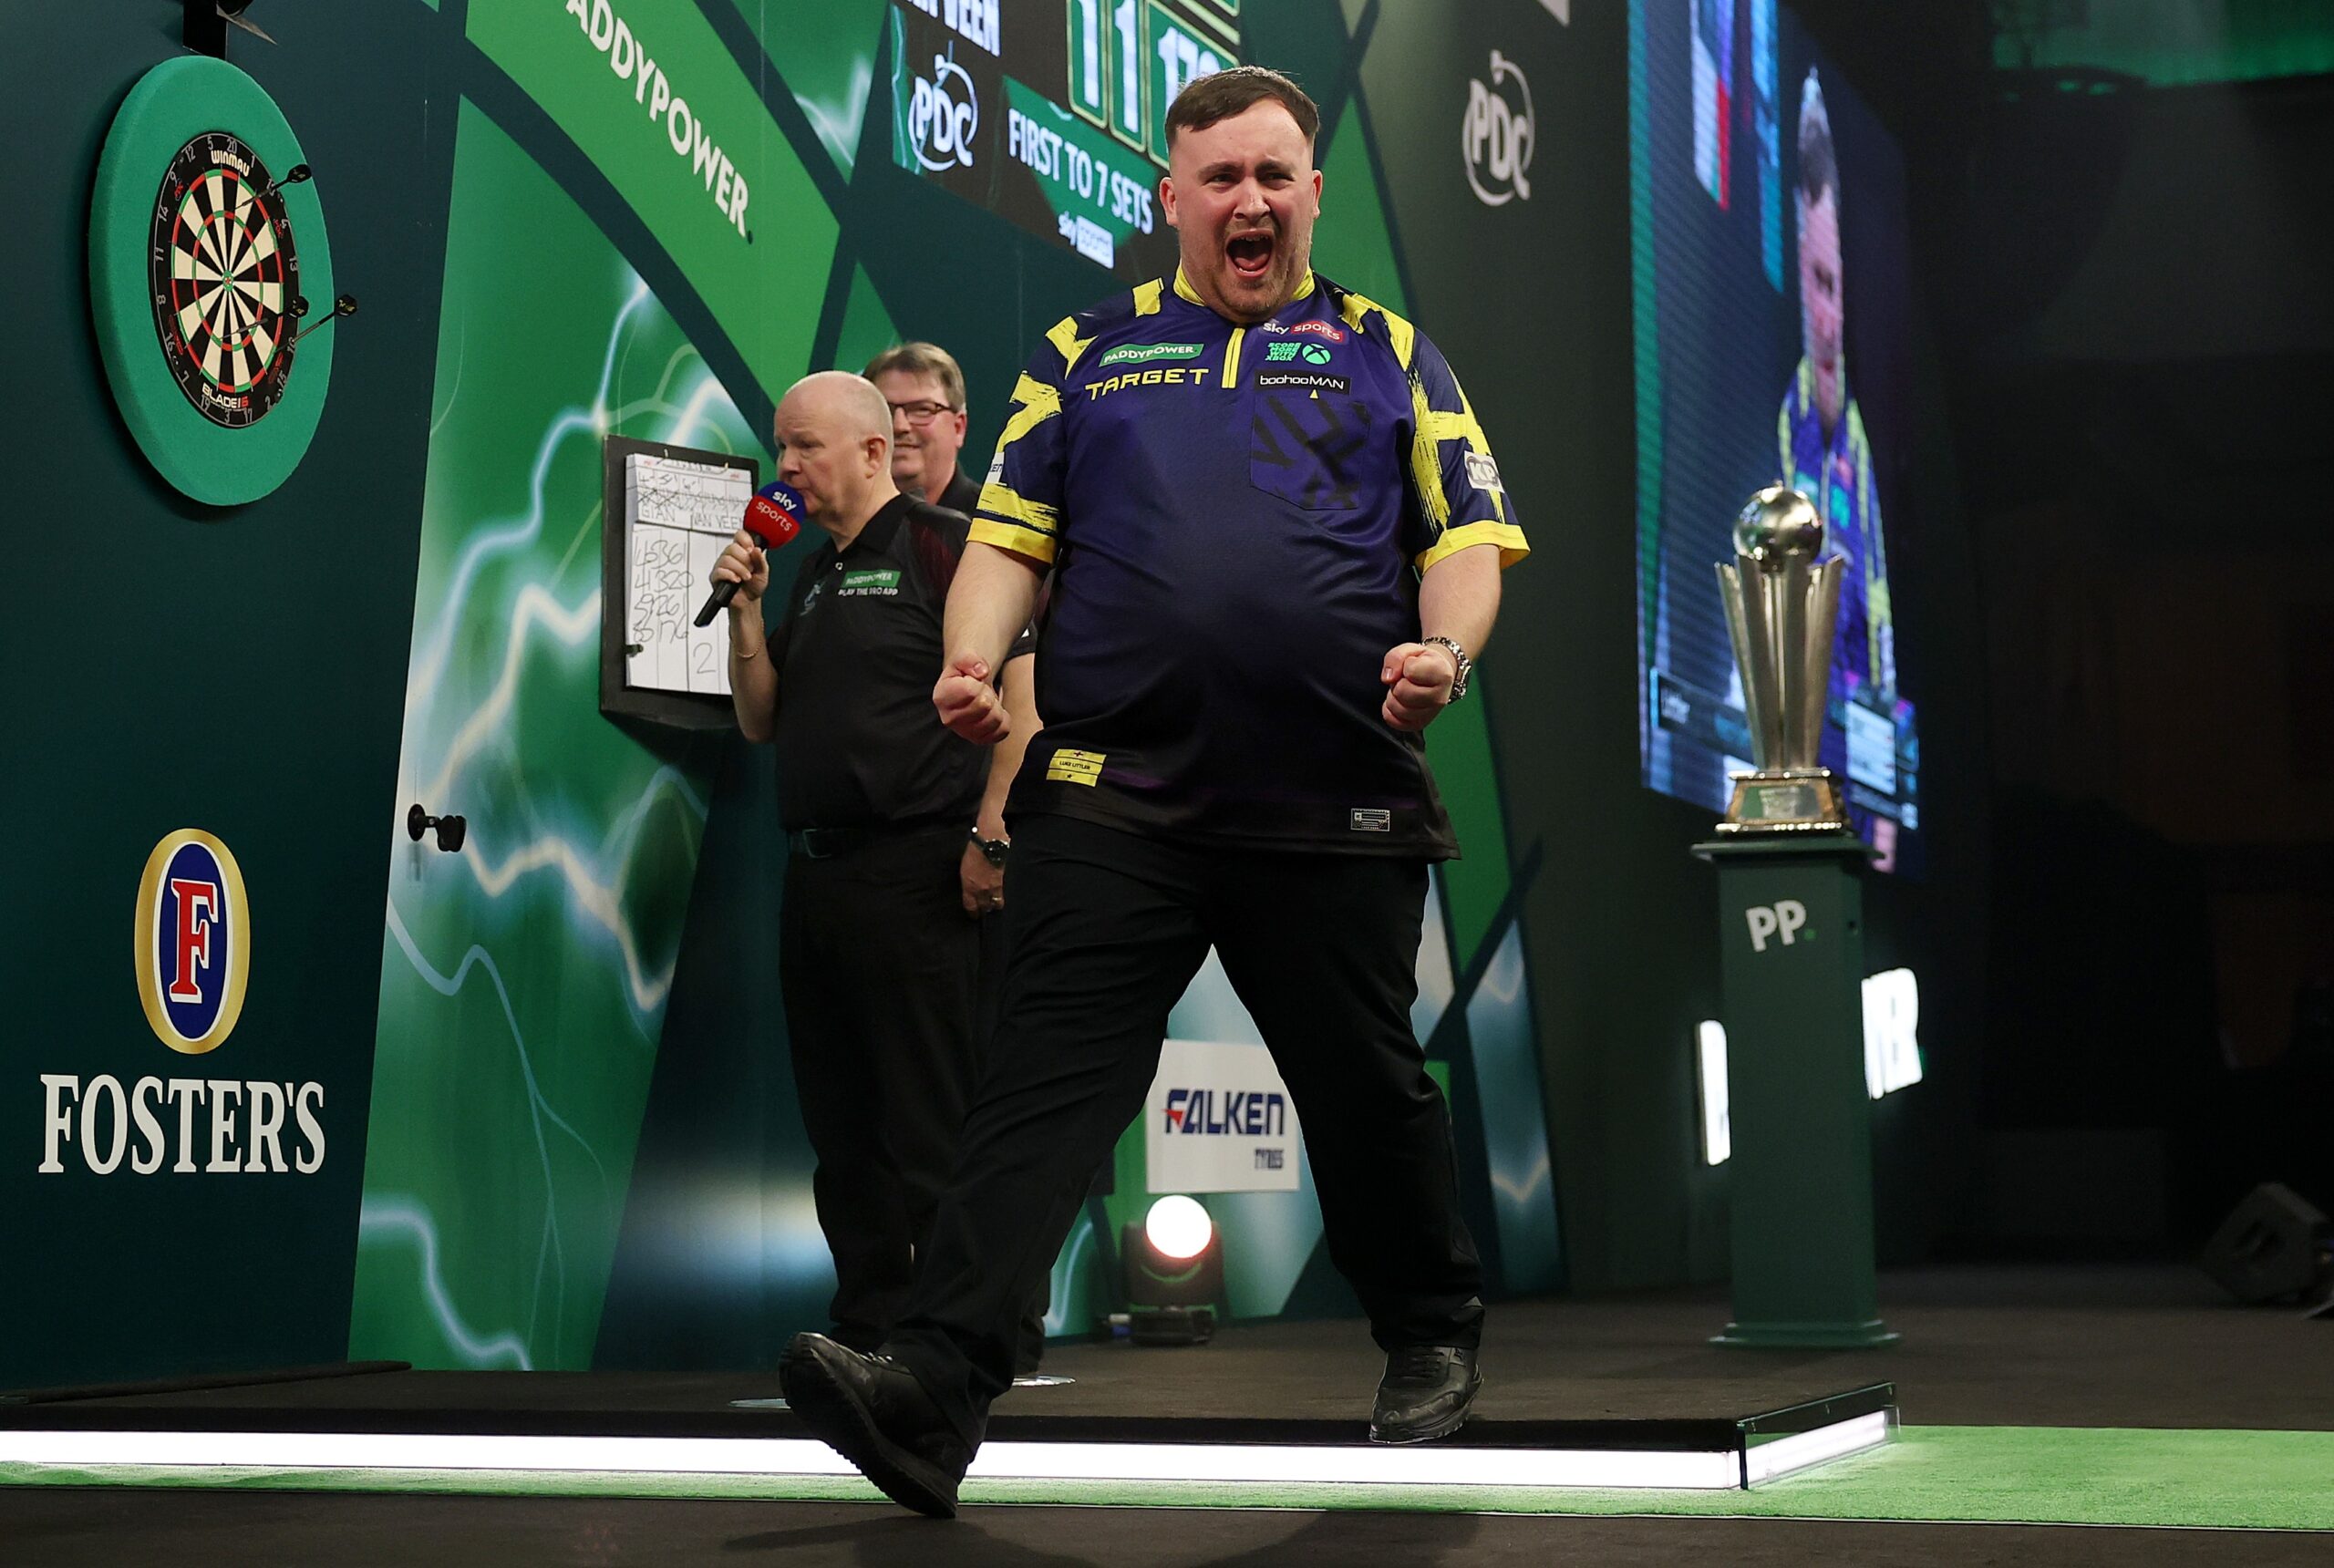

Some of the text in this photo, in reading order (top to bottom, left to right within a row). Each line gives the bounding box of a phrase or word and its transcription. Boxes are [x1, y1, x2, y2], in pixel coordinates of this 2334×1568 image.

[914, 77, 975, 168] PDC
[207, 137, 214, 150] 5
[227, 138, 238, 154] 20
[1470, 78, 1531, 201] PDC
[185, 146, 196, 162] 12
[1007, 108, 1153, 234] FIRST TO 7 SETS
[158, 206, 170, 222] 14
[288, 256, 299, 272] 13
[157, 294, 166, 305] 8
[1263, 322, 1340, 340] sky sports
[165, 332, 176, 352] 16
[1085, 368, 1210, 401] TARGET
[1259, 375, 1345, 390] boohooMAN
[772, 491, 798, 511] sky
[756, 501, 792, 531] sports
[654, 570, 695, 593] 320
[693, 642, 717, 675] 2
[169, 877, 219, 1004] F
[1164, 1088, 1286, 1136] FALKEN
[38, 1074, 326, 1175] FOSTER'S
